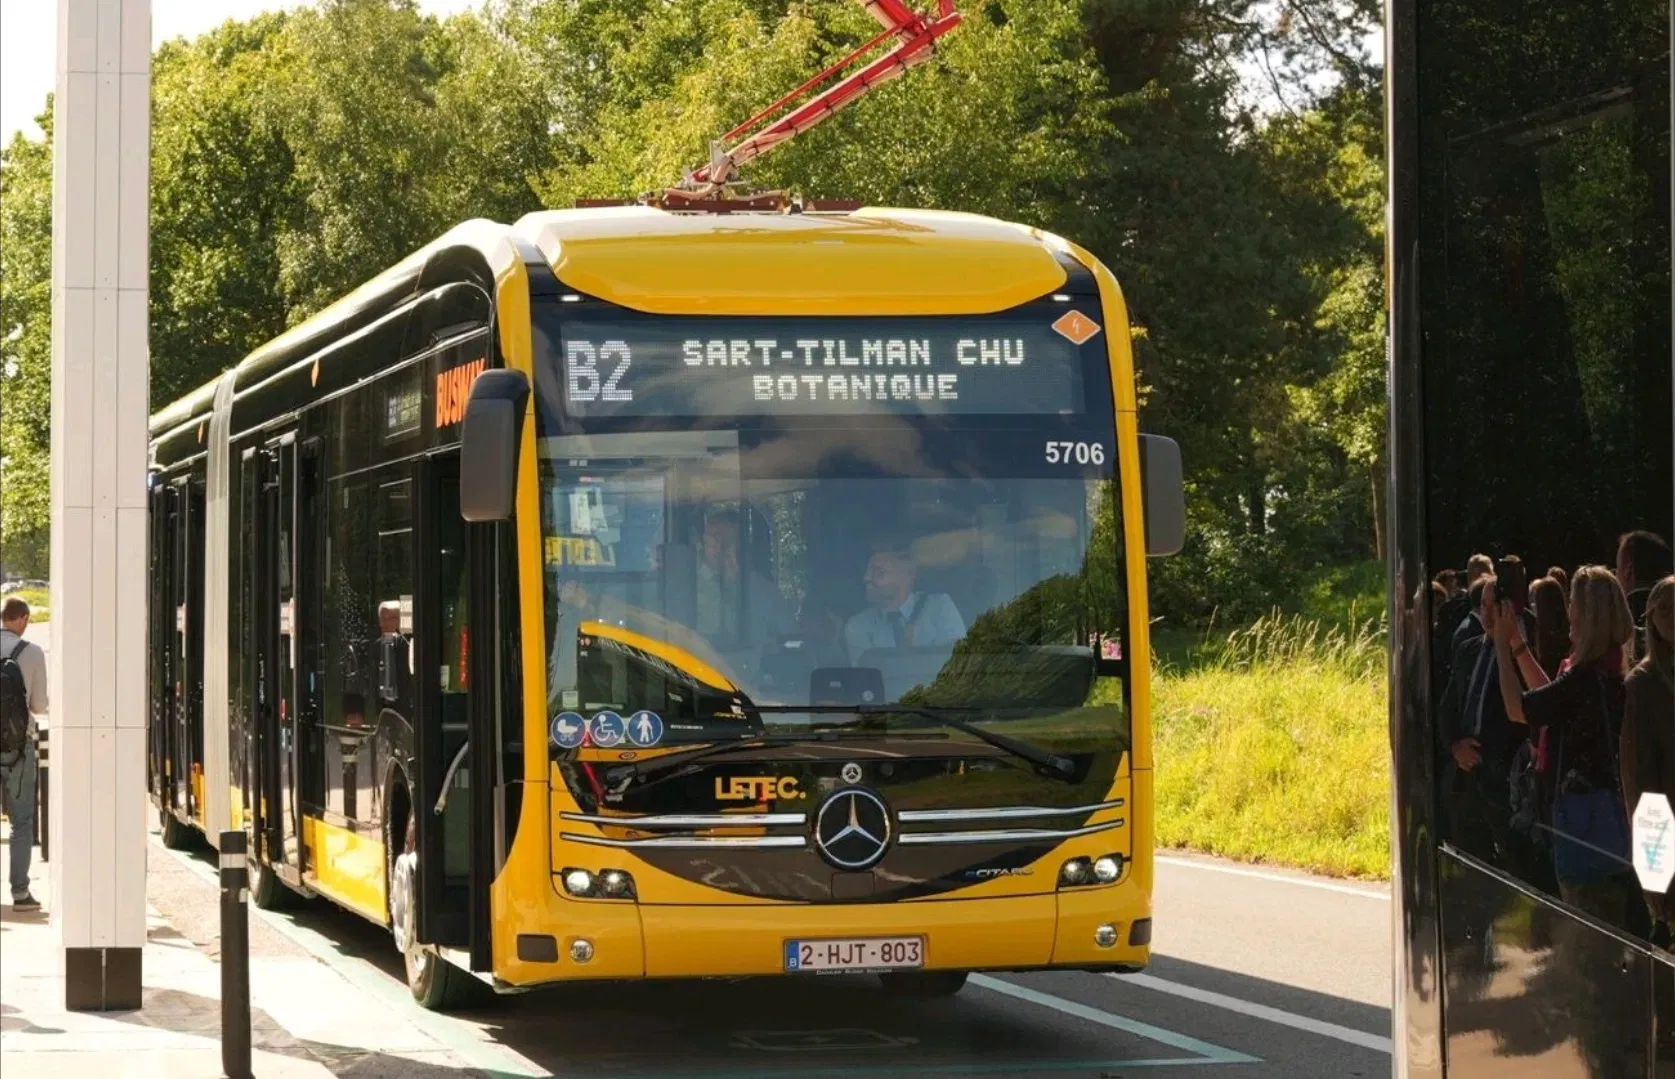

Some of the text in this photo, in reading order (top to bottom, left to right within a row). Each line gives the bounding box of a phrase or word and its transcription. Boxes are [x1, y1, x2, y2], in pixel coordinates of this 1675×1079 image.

[683, 339, 1024, 366] SART-TILMAN CHU
[567, 340, 633, 401] B2
[436, 357, 485, 428] BUSW
[753, 374, 958, 400] BOTANIQUE
[1045, 441, 1105, 465] 5706
[715, 776, 806, 800] LETEC.
[789, 942, 919, 968] B 2-HJT-803
